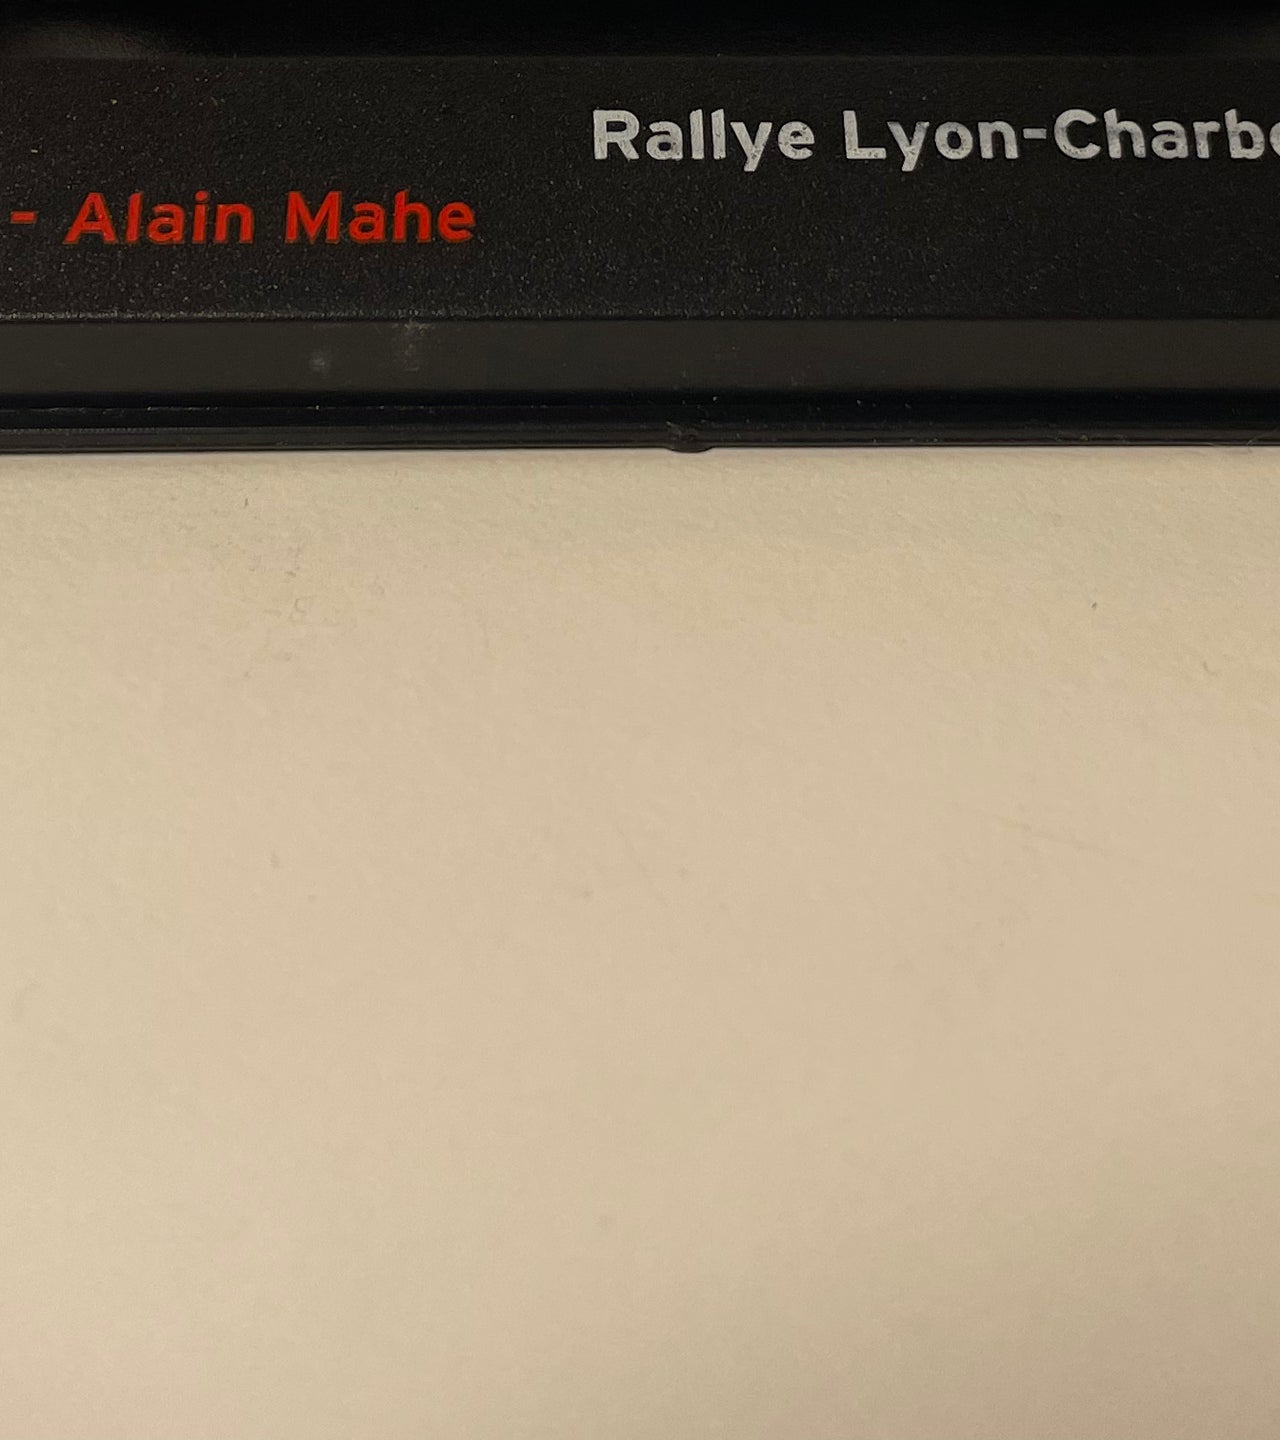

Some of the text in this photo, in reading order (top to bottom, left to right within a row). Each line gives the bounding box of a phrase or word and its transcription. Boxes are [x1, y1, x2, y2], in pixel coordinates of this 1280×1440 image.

[591, 108, 815, 172] Rallye
[62, 189, 254, 245] Alain
[284, 188, 476, 244] Mahe
